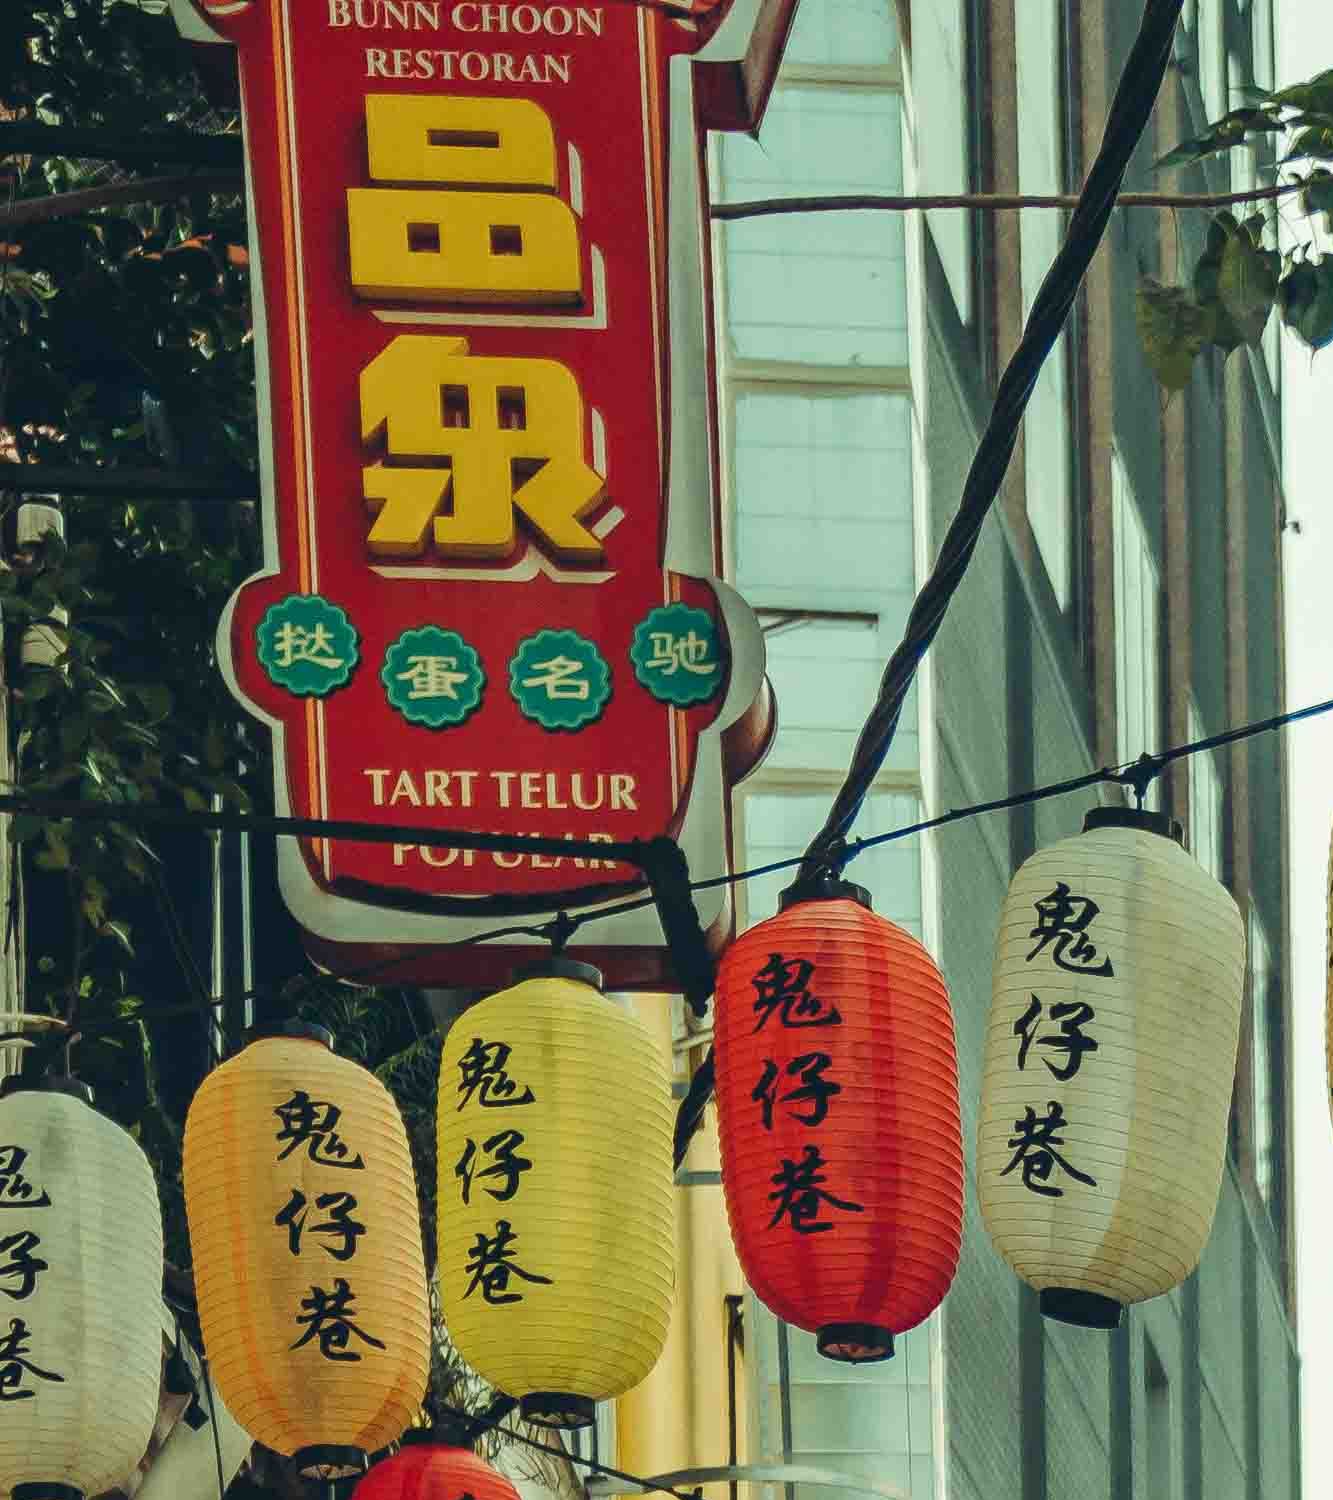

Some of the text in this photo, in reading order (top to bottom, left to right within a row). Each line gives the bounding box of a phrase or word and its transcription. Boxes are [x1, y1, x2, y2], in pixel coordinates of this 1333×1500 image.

[327, 0, 604, 36] BUNN CHOON
[363, 47, 572, 83] RESTORAN
[363, 769, 638, 811] TART TELUR
[454, 1037, 553, 1305] 鬼仔巷
[750, 952, 864, 1234] 鬼仔巷
[999, 881, 1114, 1197] 鬼仔巷
[272, 1090, 387, 1362] 鬼仔巷
